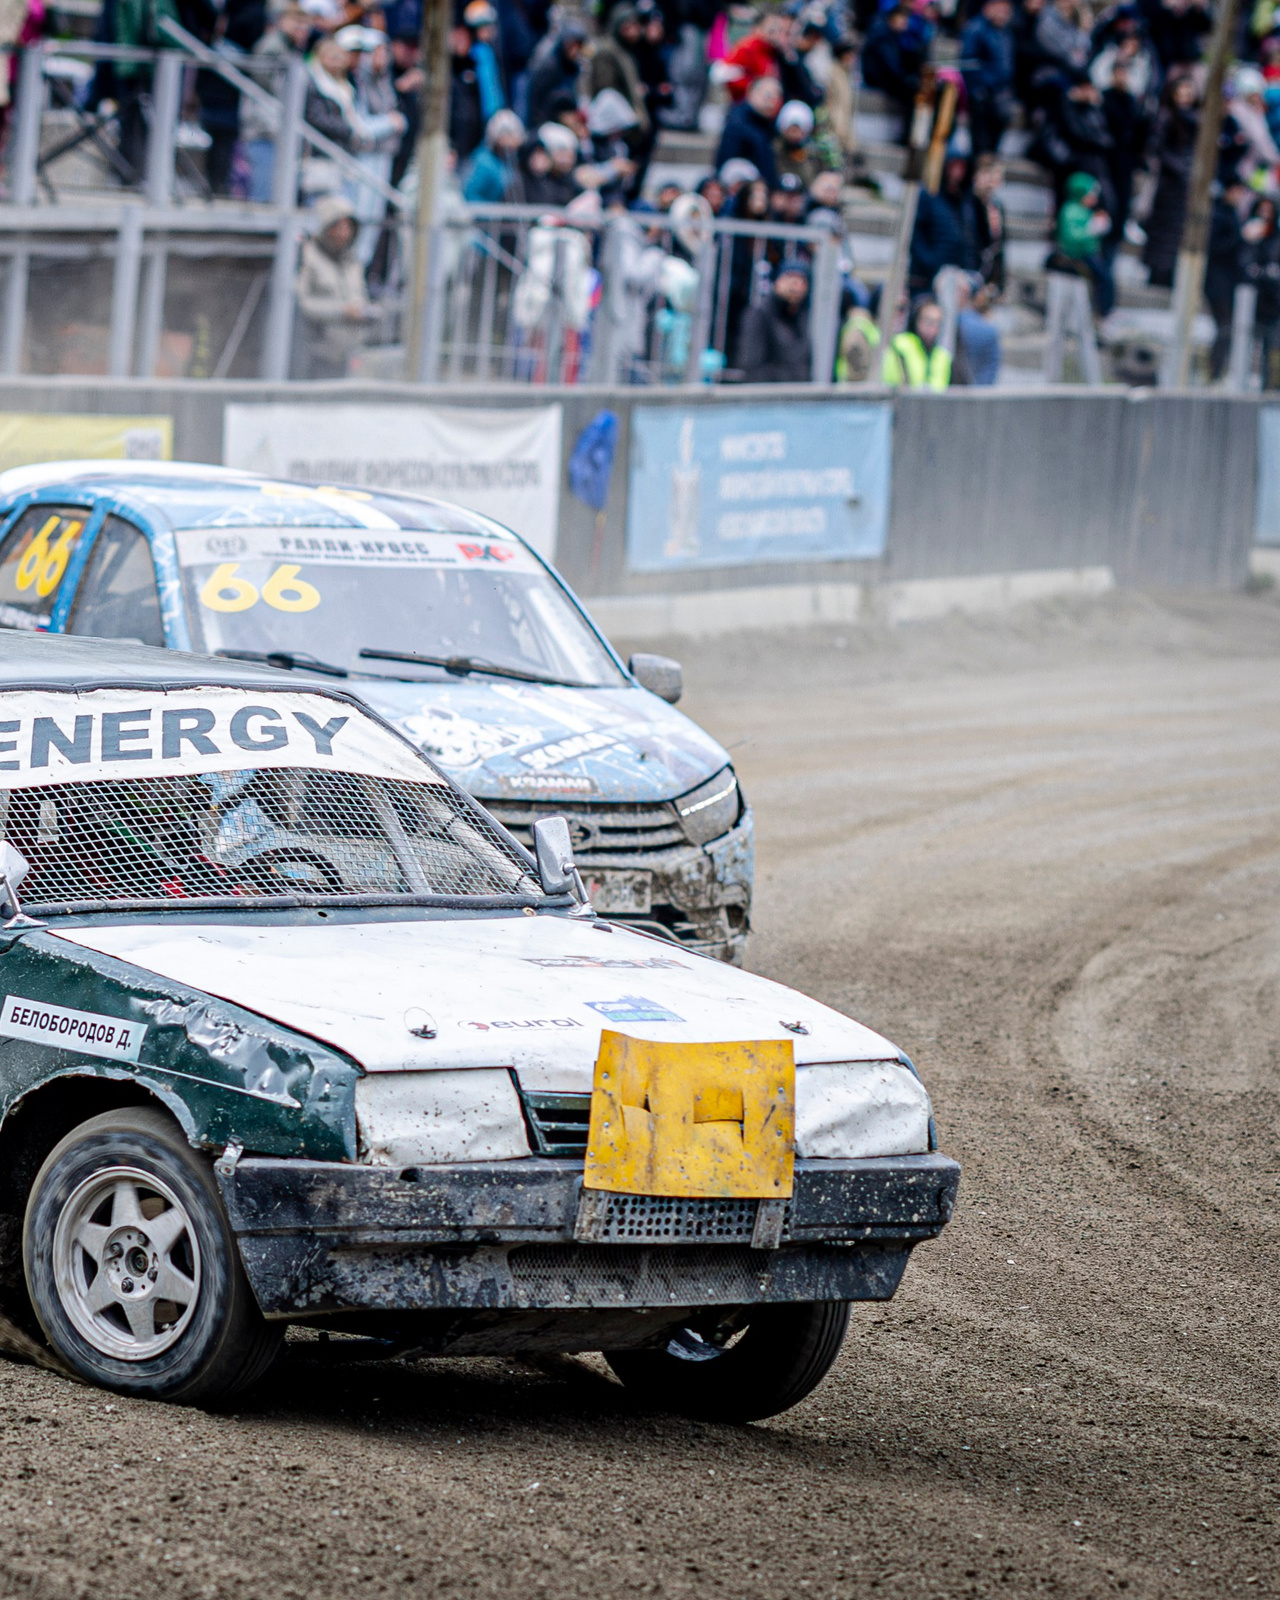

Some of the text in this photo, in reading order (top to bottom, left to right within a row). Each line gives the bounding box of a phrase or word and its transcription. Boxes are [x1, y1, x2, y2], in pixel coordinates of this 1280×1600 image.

[16, 515, 83, 597] 66
[200, 563, 321, 613] 66
[9, 1006, 132, 1051] БЕЛОБОРОДОВ Д.
[490, 1017, 584, 1029] eurol
